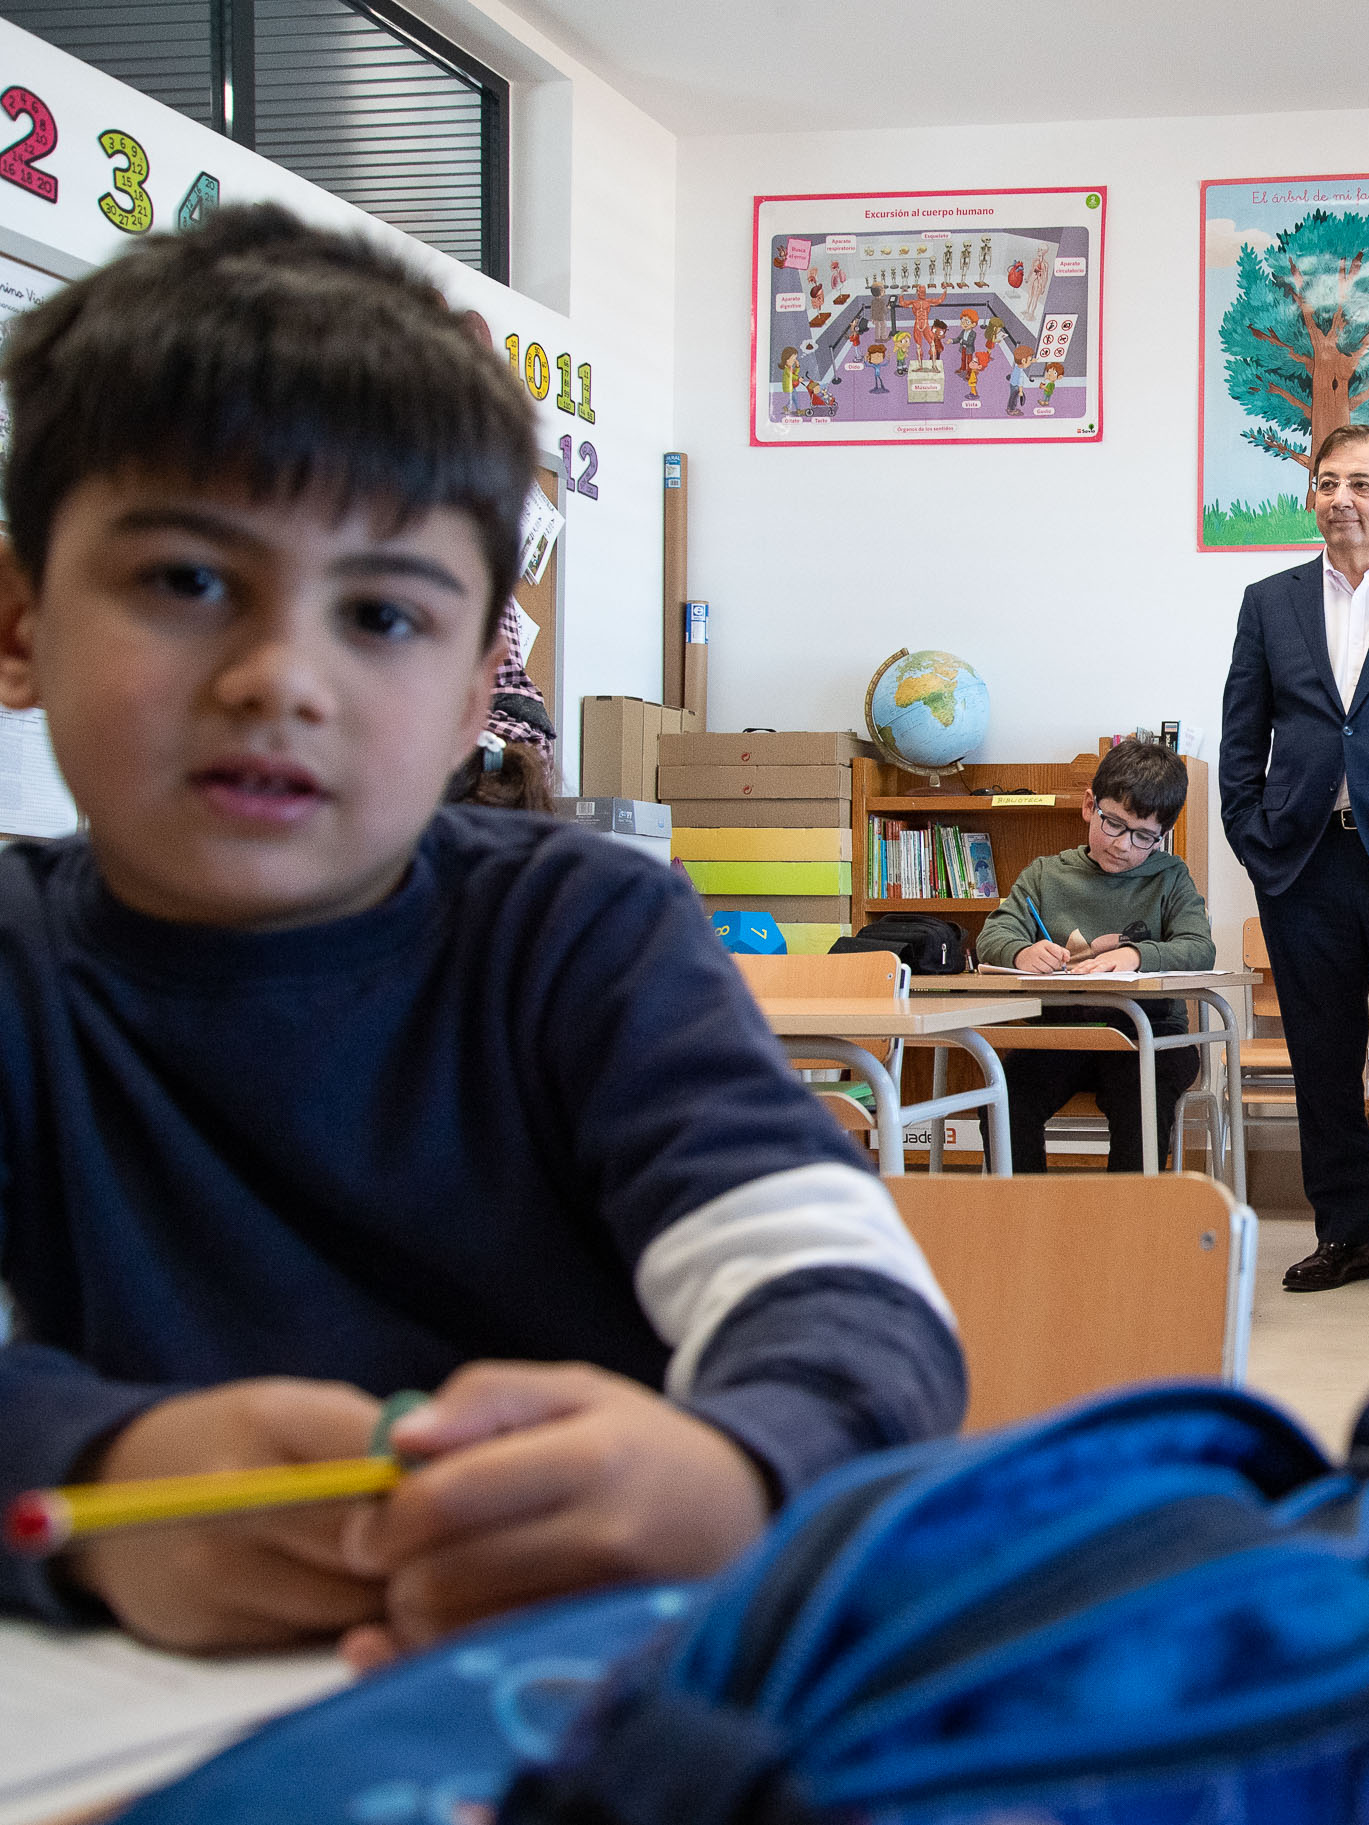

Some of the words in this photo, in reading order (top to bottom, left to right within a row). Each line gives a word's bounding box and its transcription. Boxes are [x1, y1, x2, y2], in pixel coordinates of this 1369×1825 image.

[9, 95, 15, 109] 2
[32, 101, 39, 114] 6
[109, 136, 115, 150] 3
[120, 137, 127, 150] 6
[131, 145, 138, 158] 9
[0, 85, 58, 204] 2
[97, 129, 153, 235] 3
[3, 159, 16, 176] 16
[21, 168, 33, 185] 18
[37, 176, 52, 194] 20
[132, 162, 144, 176] 12
[122, 175, 133, 188] 15
[205, 178, 215, 191] 20
[134, 189, 144, 202] 18
[1252, 191, 1267, 204] El
[1272, 189, 1310, 203] árbol
[1313, 189, 1329, 202] de
[1333, 190, 1352, 201] mi
[105, 203, 117, 216] 30
[119, 214, 129, 227] 27
[131, 215, 143, 229] 24
[137, 204, 148, 218] 21
[865, 209, 909, 219] Excursión
[911, 208, 920, 217] al
[922, 209, 954, 218] cuerpo
[956, 207, 994, 216] humano
[505, 333, 550, 401] 10
[557, 352, 595, 425] 11
[560, 434, 599, 501] 12
[997, 796, 1043, 804] BIBLIOTECA
[714, 925, 730, 937] 8
[750, 927, 768, 940] 7
